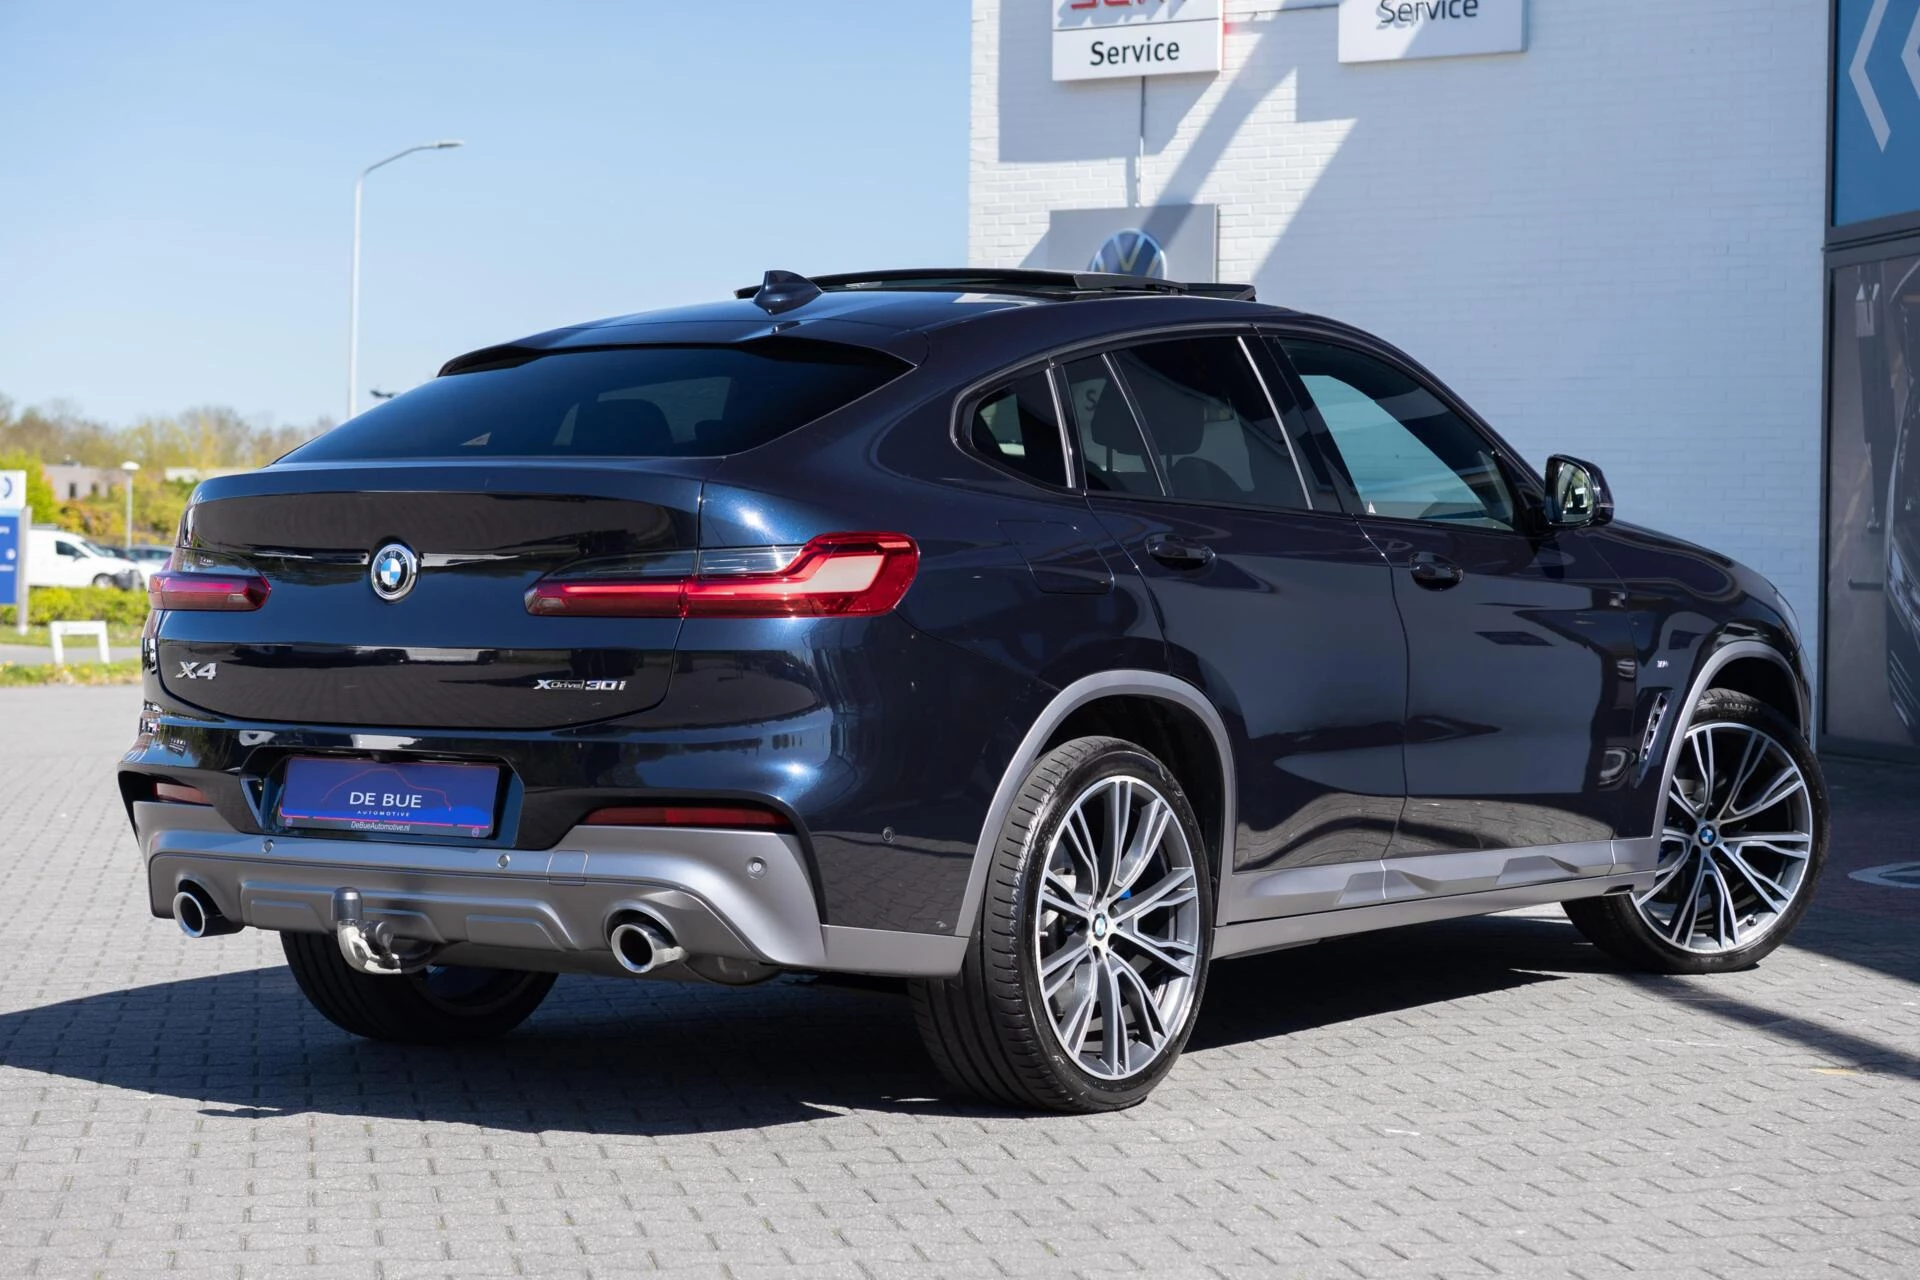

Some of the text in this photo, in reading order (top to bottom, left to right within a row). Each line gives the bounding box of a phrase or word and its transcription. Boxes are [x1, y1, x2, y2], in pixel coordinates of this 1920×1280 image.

[1380, 0, 1479, 24] Service
[1090, 36, 1180, 66] Service
[175, 661, 217, 680] X4
[349, 791, 423, 809] DE BUE
[350, 820, 411, 832] DeBueAutomotive.nl
